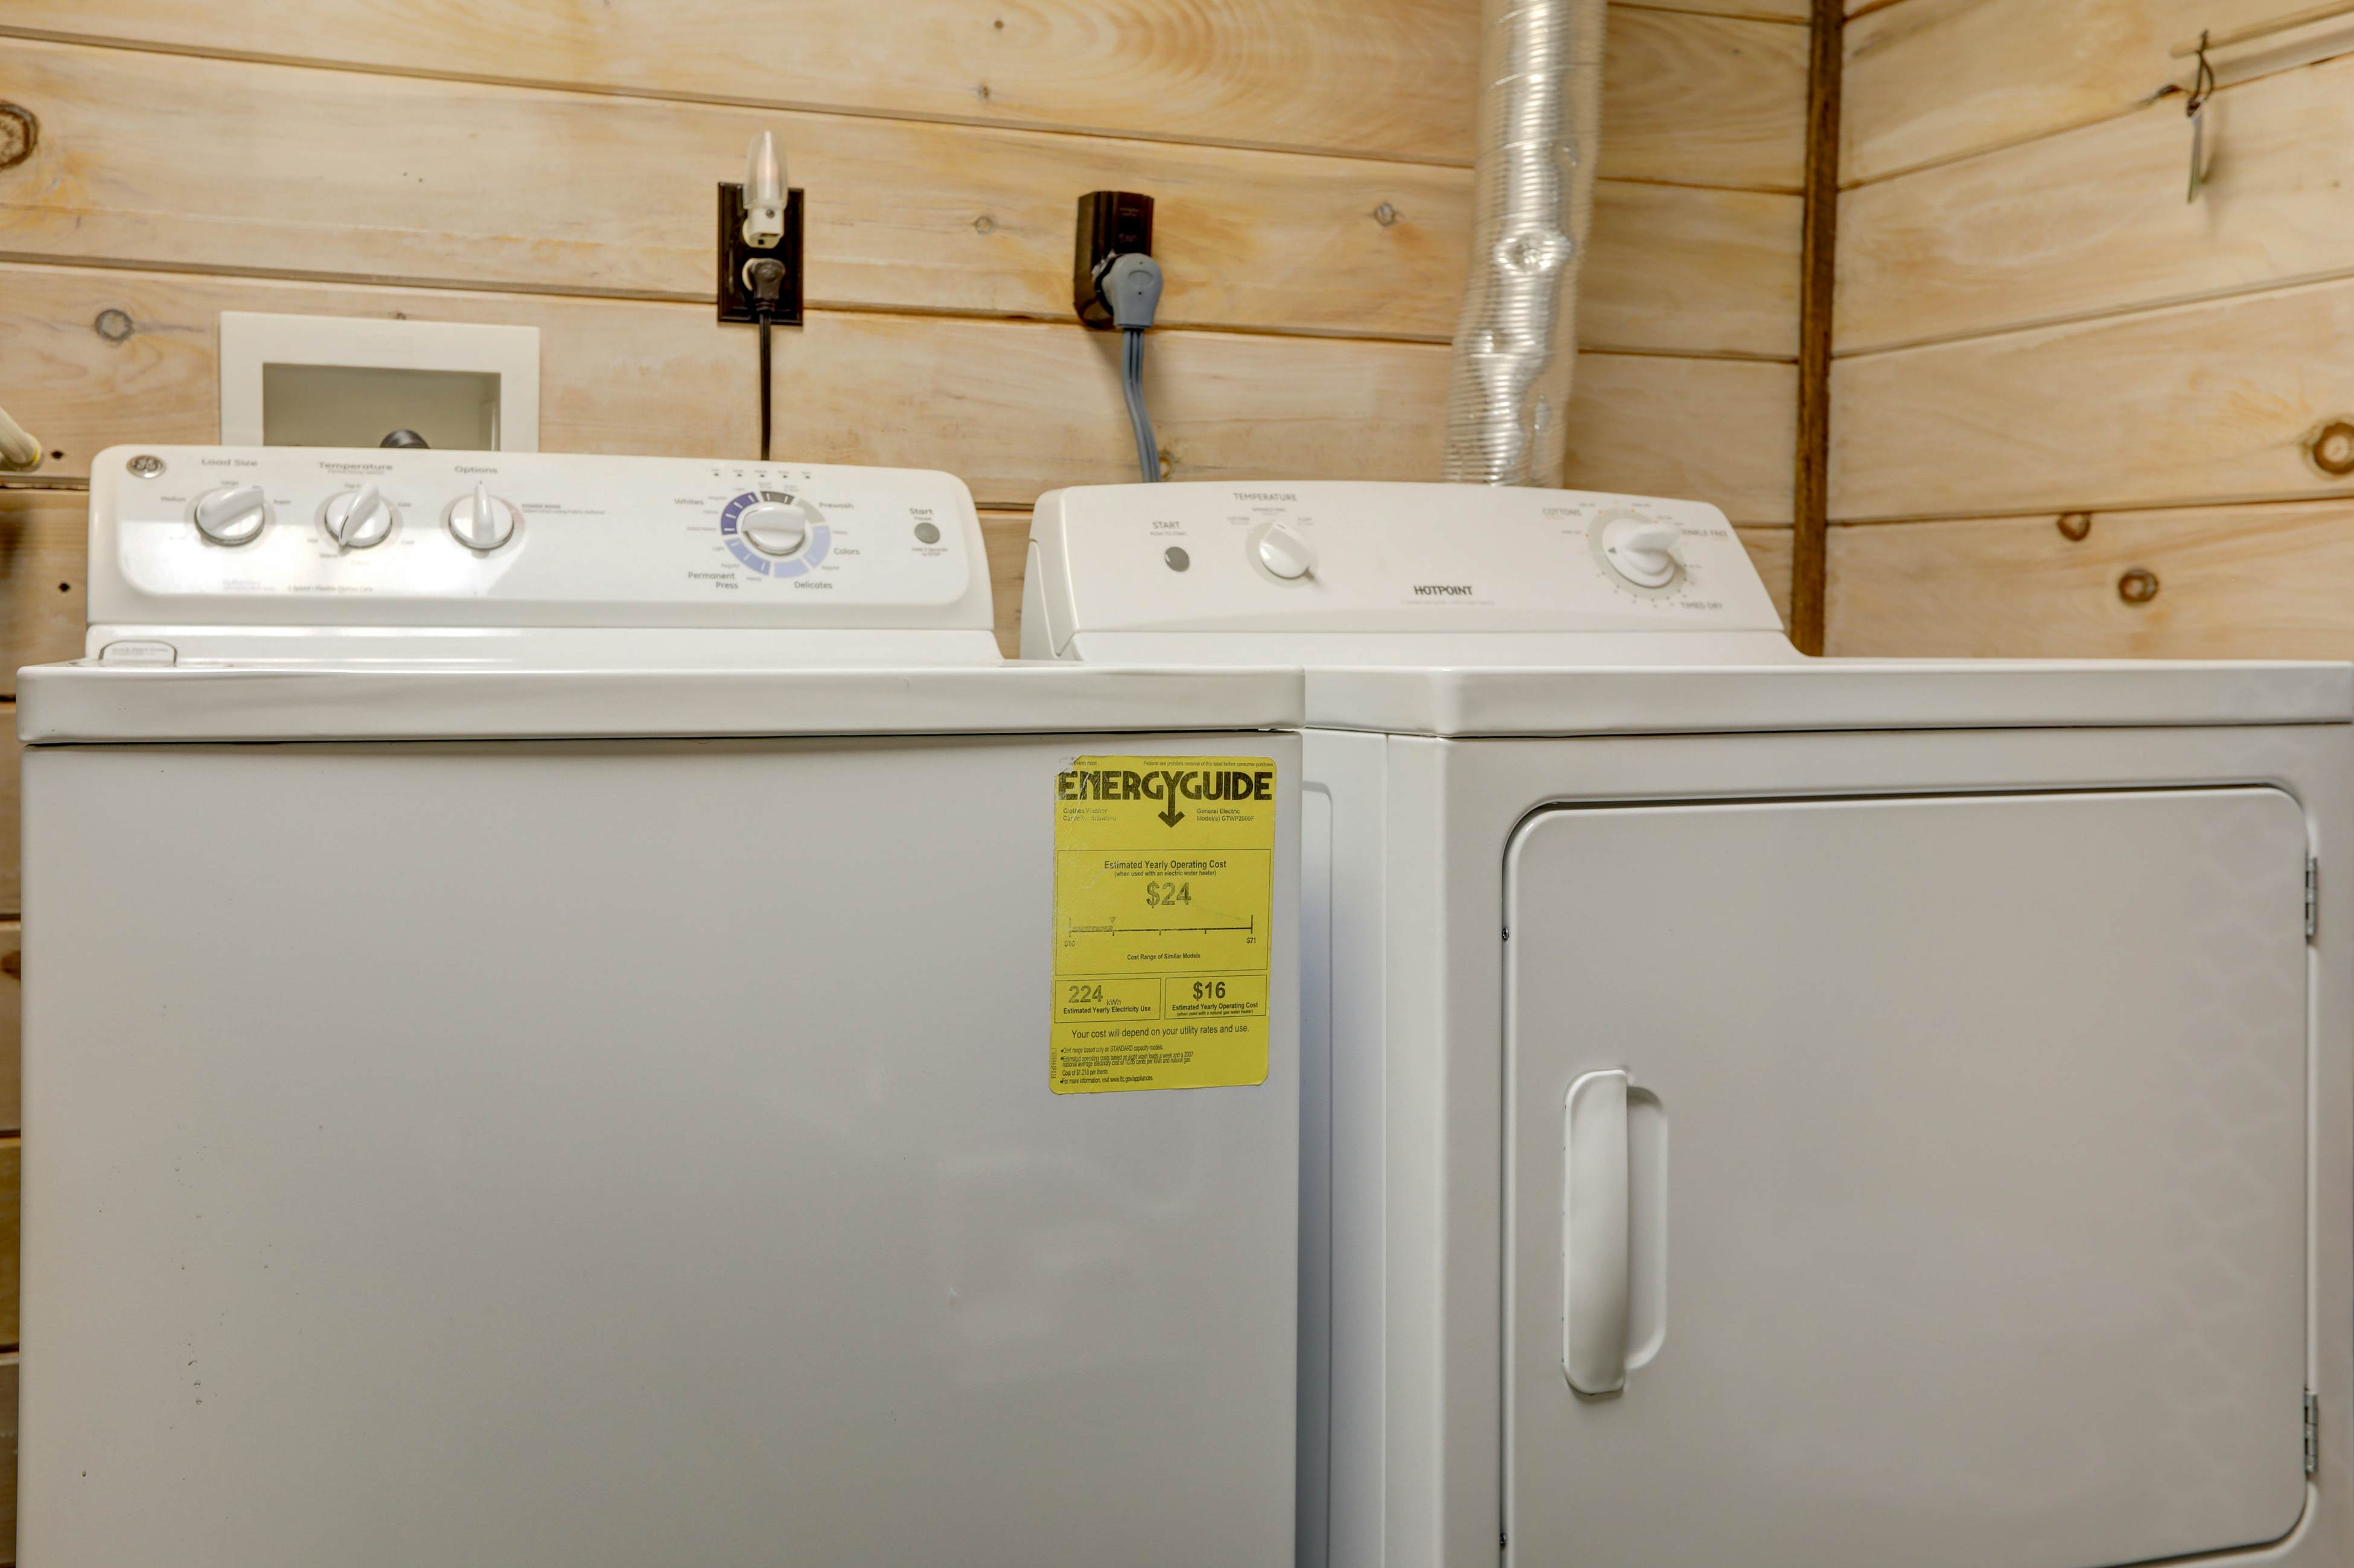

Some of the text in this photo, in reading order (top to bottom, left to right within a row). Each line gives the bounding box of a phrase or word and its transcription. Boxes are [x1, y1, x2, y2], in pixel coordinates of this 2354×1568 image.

[319, 462, 393, 471] Temperature
[455, 465, 499, 474] Options
[1233, 492, 1298, 502] TEMPERATURE
[1542, 508, 1582, 517] COTTONS
[1152, 521, 1180, 529] START
[688, 572, 735, 580] Permanent
[794, 581, 833, 590] Delicates
[1414, 585, 1472, 595] HOTPOINT
[1058, 771, 1272, 801] ENERGYGUIDE
[1104, 859, 1227, 870] Estimated Yearly Operating Cost
[1146, 881, 1191, 908] $24
[1140, 953, 1158, 961] Range
[1068, 984, 1103, 1003] 224
[1193, 981, 1226, 1001] $16
[1111, 1004, 1139, 1013] Electricity
[1071, 1030, 1089, 1038] Your
[1091, 1029, 1106, 1037] cost
[1108, 1028, 1120, 1037] will
[1121, 1027, 1149, 1038] depend
[1163, 1028, 1178, 1037] your
[1179, 1025, 1198, 1036] utility
[1200, 1025, 1218, 1034] rates
[1219, 1024, 1233, 1033] and
